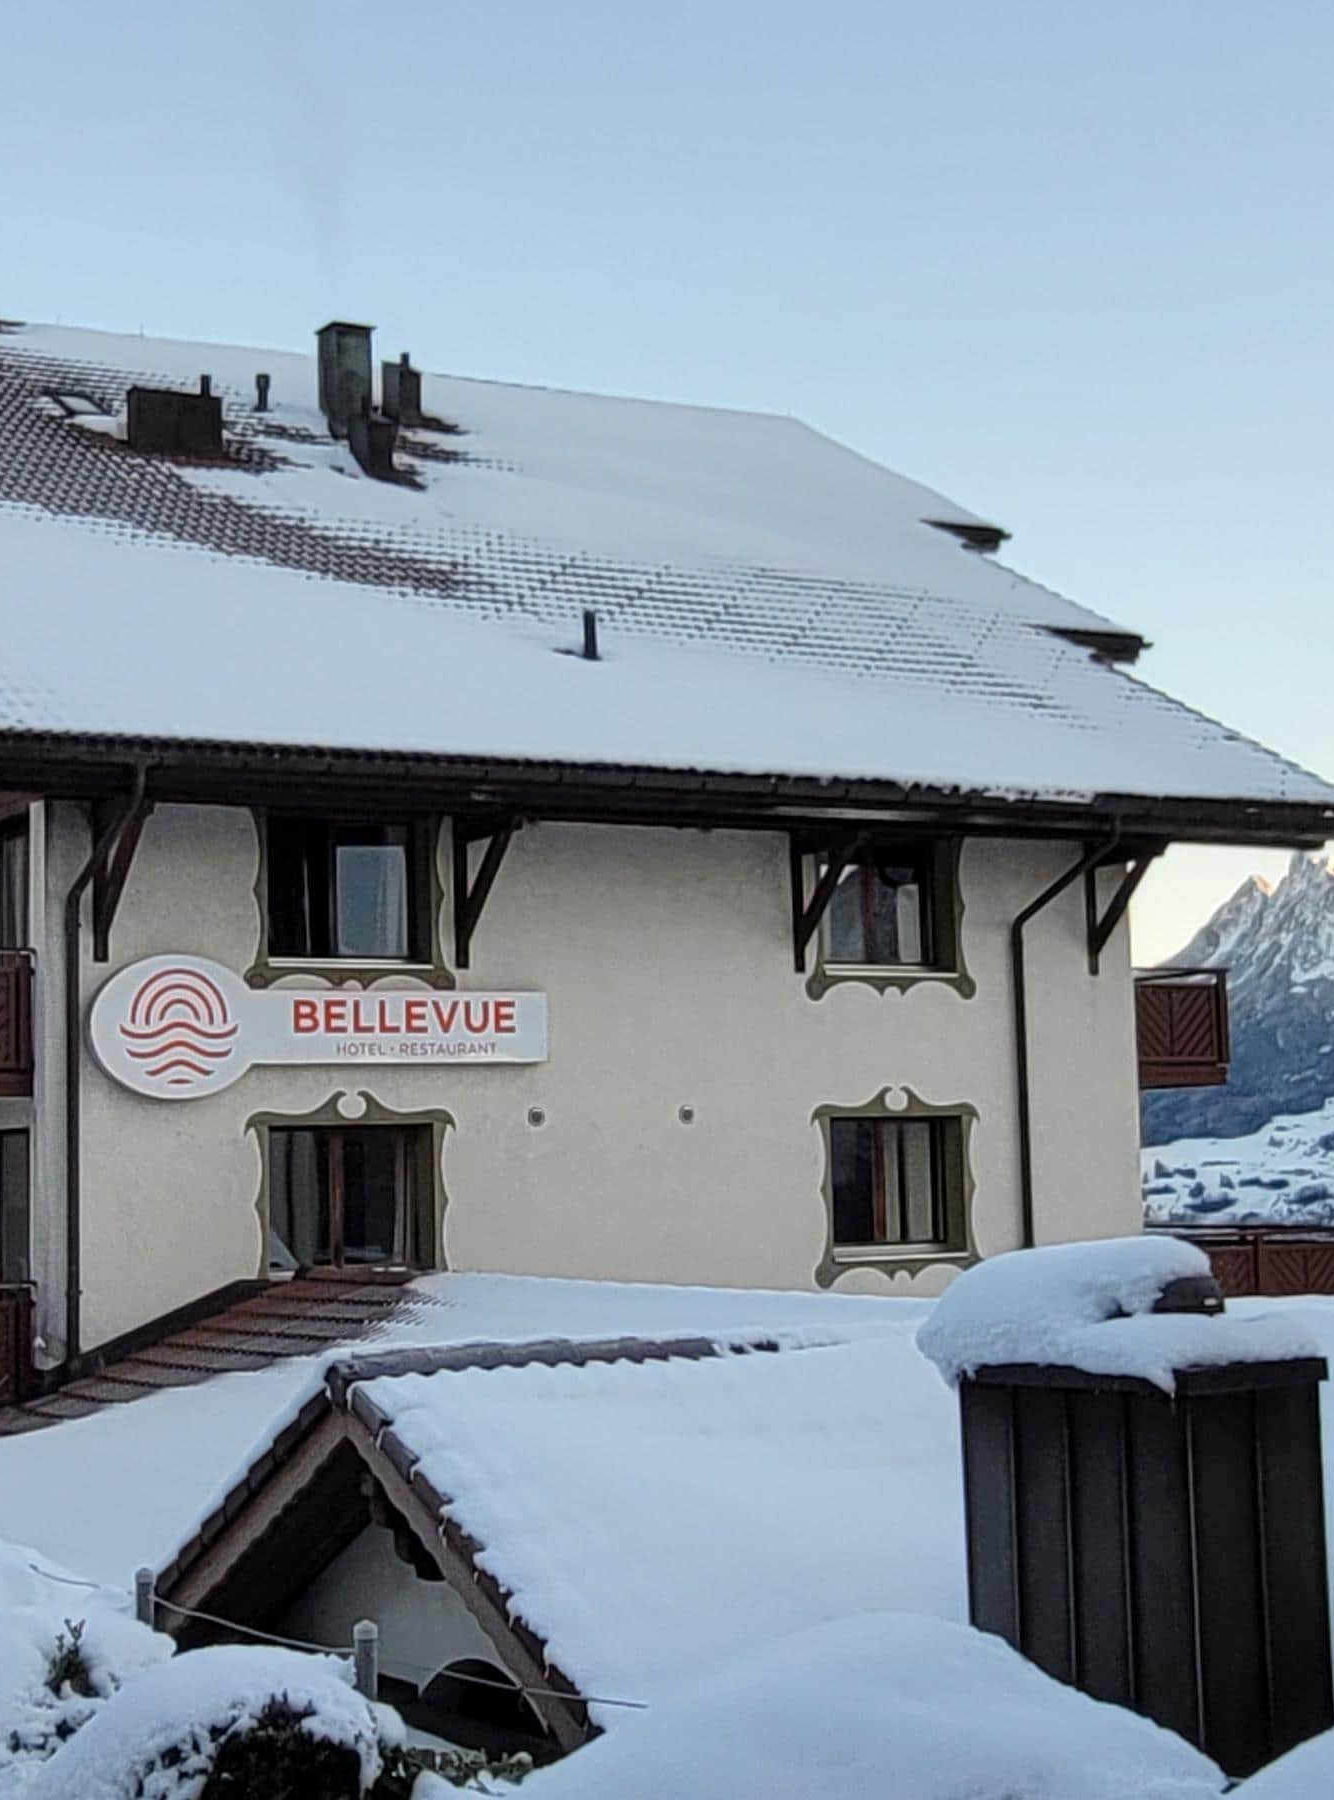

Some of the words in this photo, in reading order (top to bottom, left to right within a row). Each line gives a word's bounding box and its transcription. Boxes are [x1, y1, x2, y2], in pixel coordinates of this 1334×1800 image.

[293, 1000, 516, 1034] BELLEVUE
[336, 1042, 387, 1057] HOTEL
[399, 1042, 498, 1057] RESTAURANT
